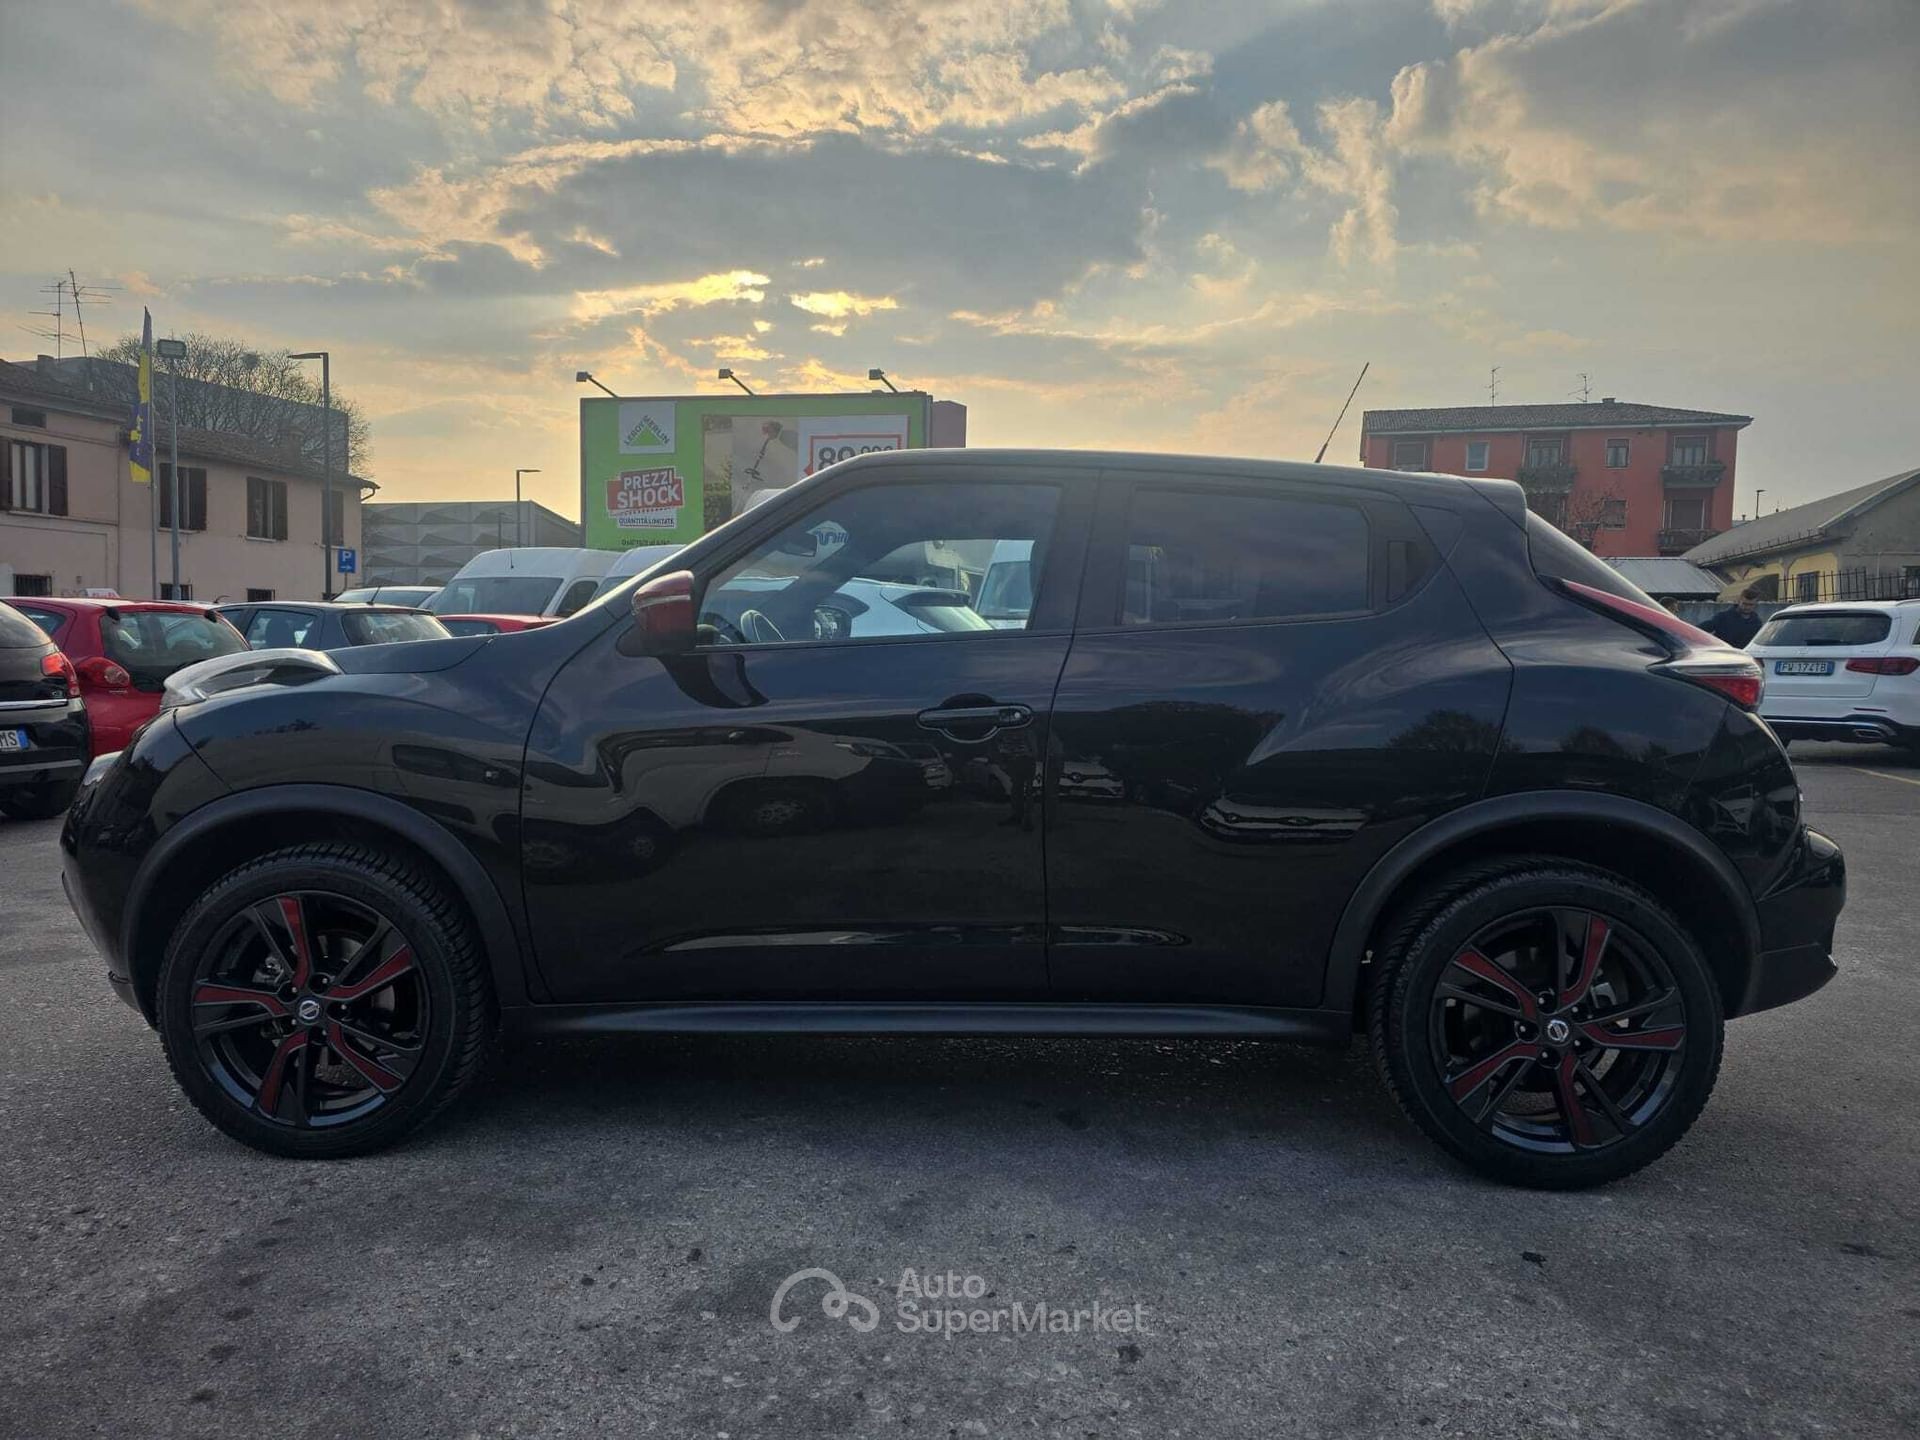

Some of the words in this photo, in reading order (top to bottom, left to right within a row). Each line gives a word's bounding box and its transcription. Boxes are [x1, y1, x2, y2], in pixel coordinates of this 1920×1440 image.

[623, 470, 673, 490] PREZZI
[617, 484, 681, 508] SHOCK
[342, 550, 352, 562] P
